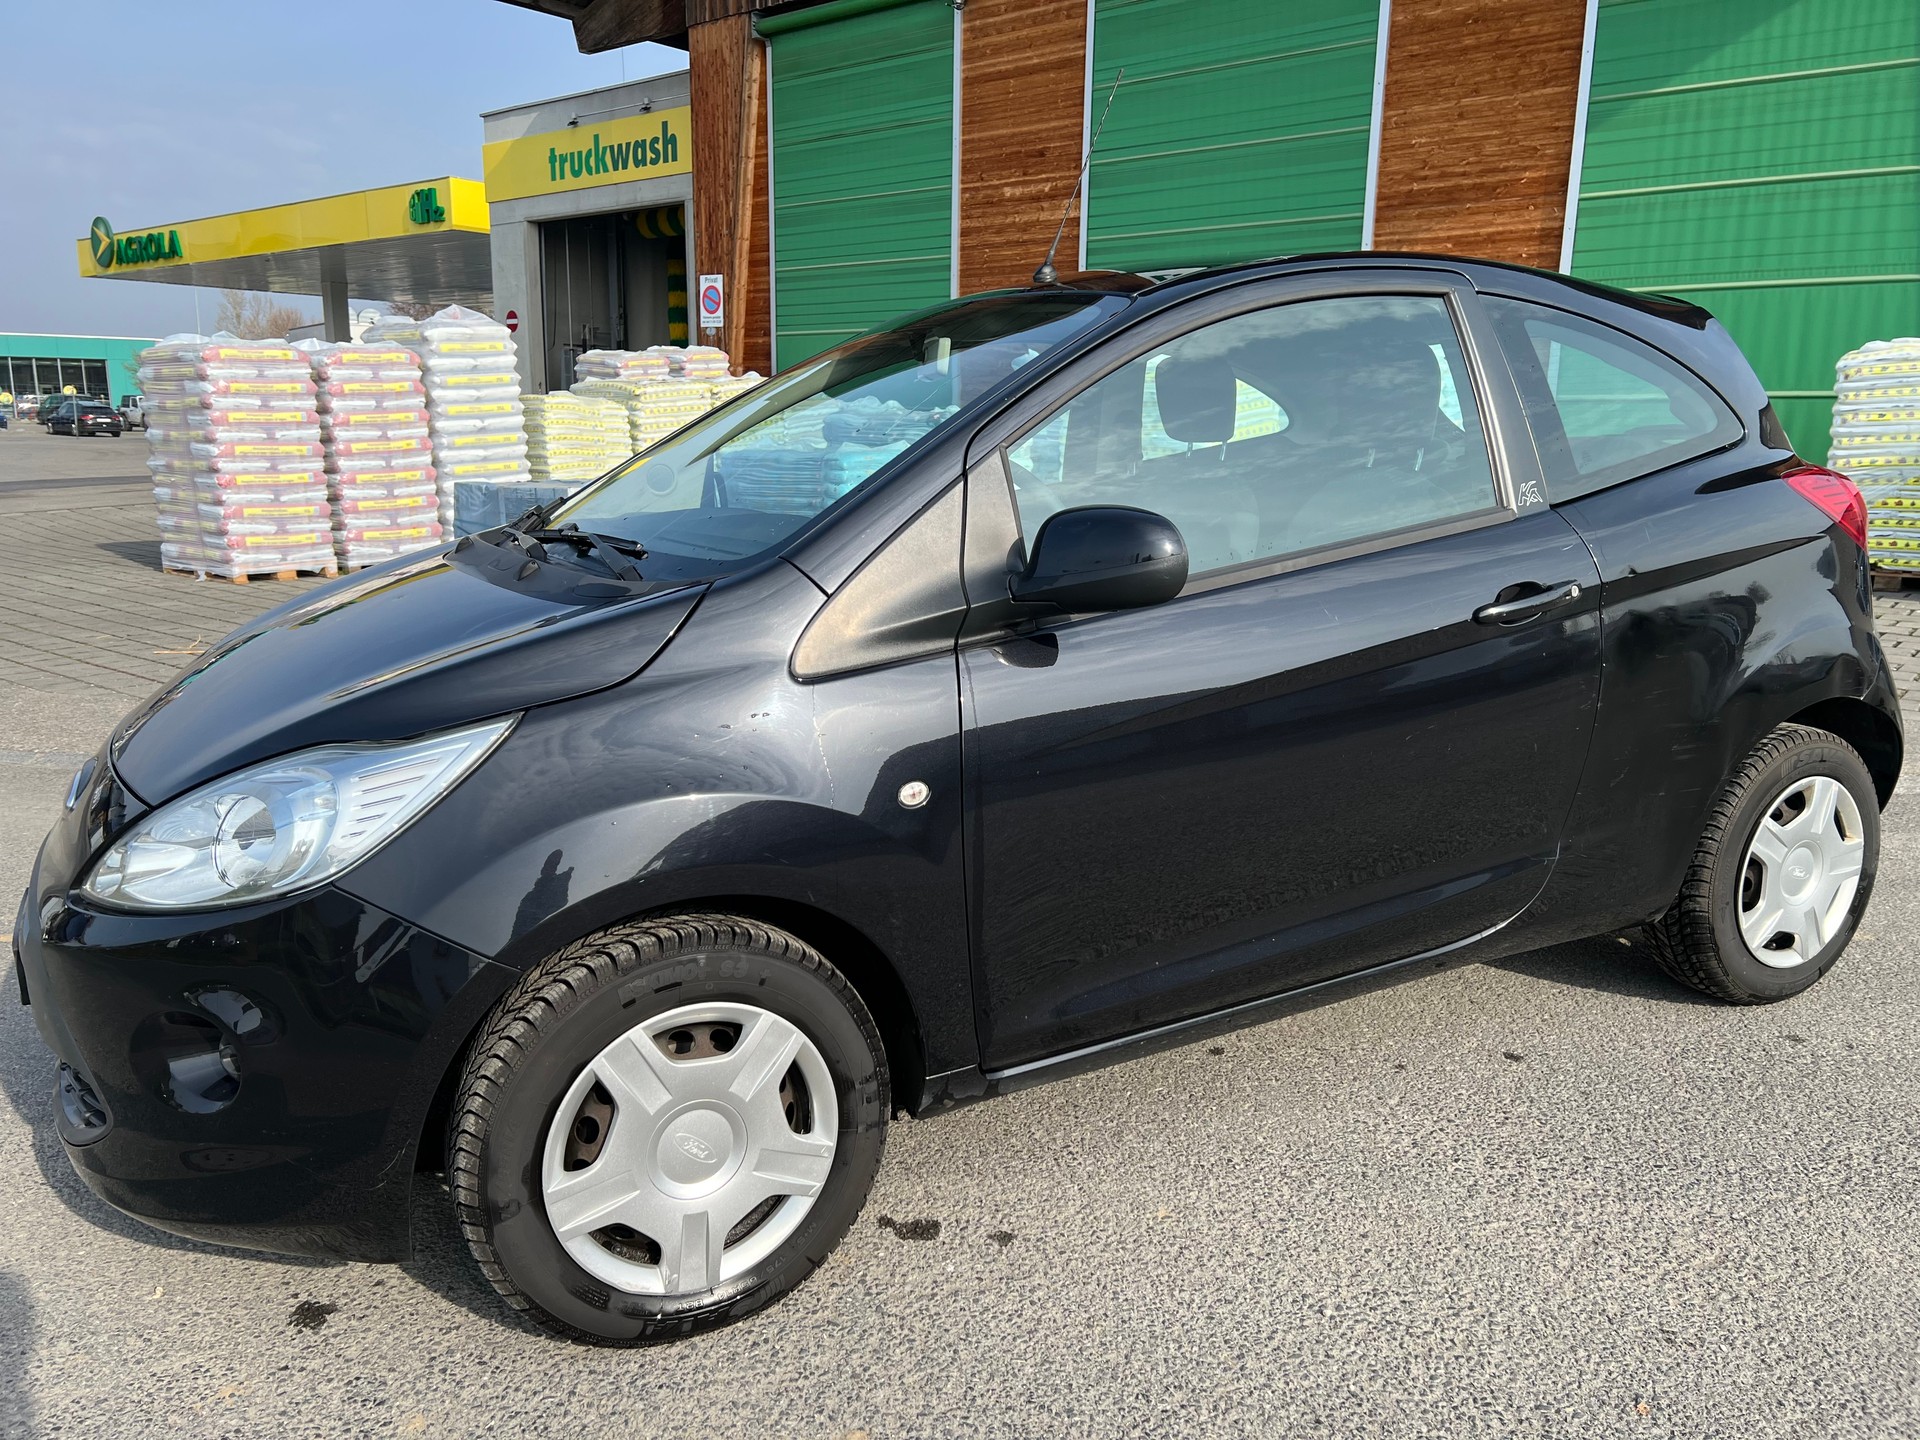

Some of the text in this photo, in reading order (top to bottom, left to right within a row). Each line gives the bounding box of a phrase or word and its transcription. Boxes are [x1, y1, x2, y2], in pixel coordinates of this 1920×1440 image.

[548, 120, 678, 182] truckwash
[115, 230, 183, 266] AGROLA
[682, 1138, 710, 1159] Ford
